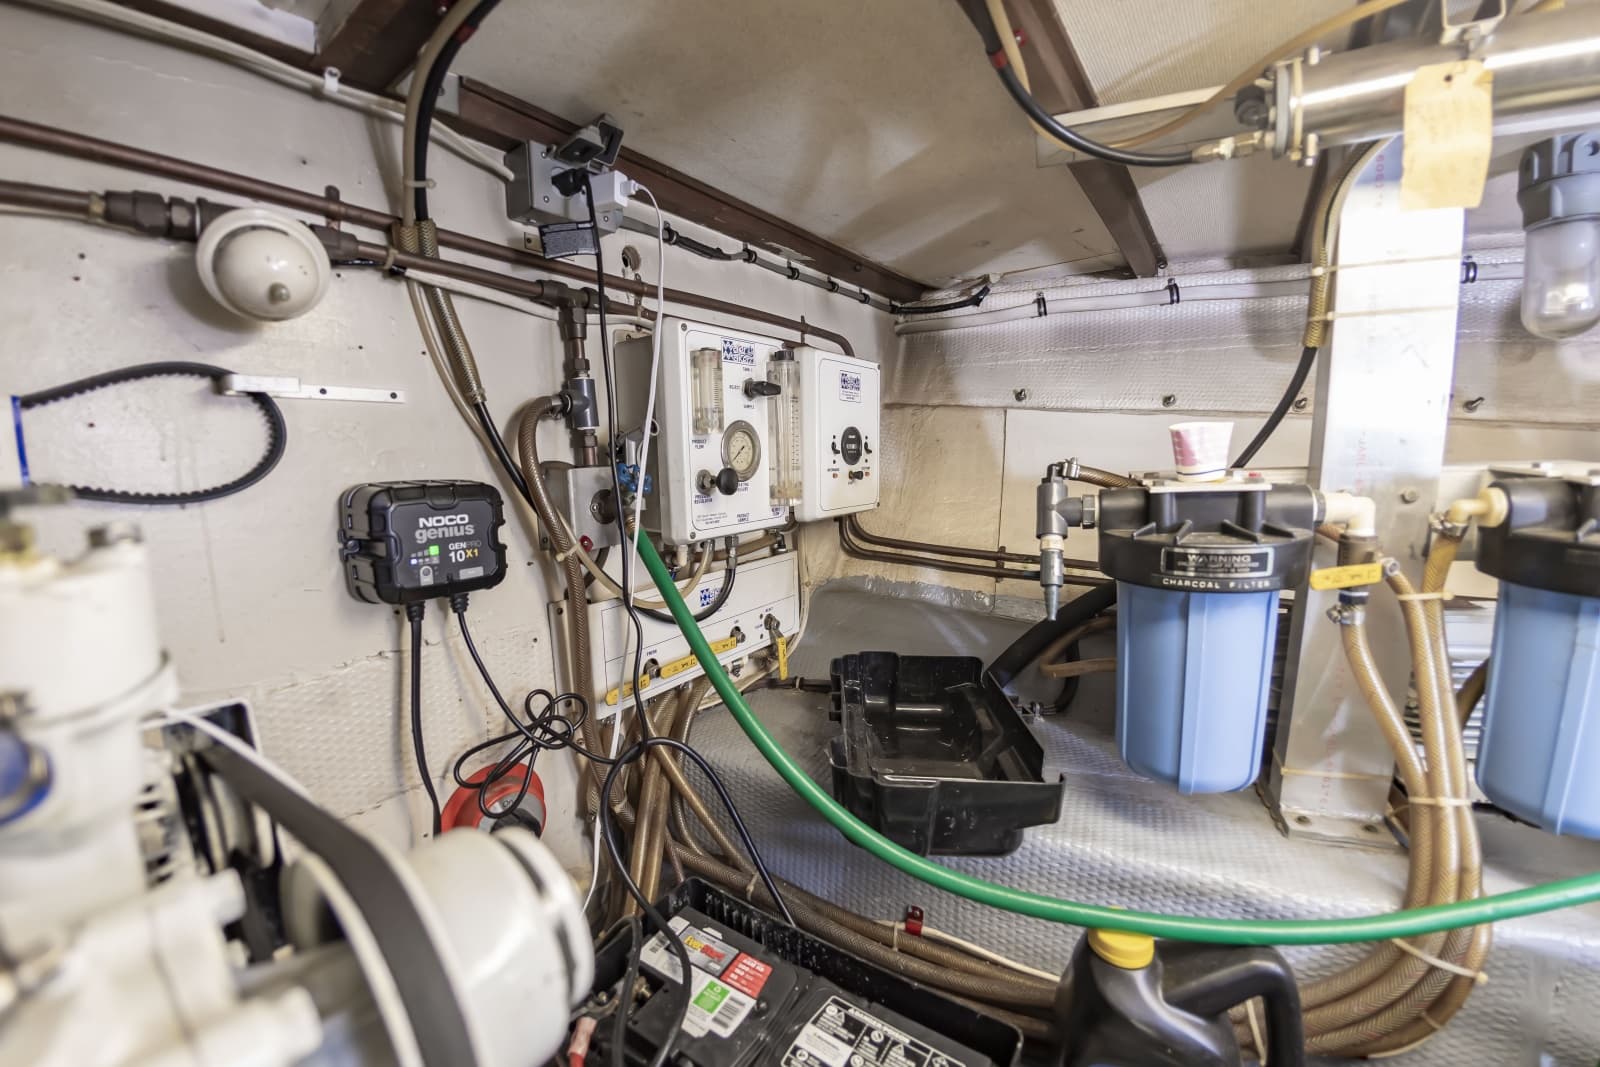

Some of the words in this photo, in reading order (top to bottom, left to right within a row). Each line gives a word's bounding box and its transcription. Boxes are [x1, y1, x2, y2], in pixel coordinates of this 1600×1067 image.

[419, 514, 470, 528] NOCO
[415, 524, 475, 544] genius
[1187, 554, 1252, 563] WARNING
[1162, 577, 1221, 589] CHARCOAL
[1229, 579, 1271, 589] FILTER
